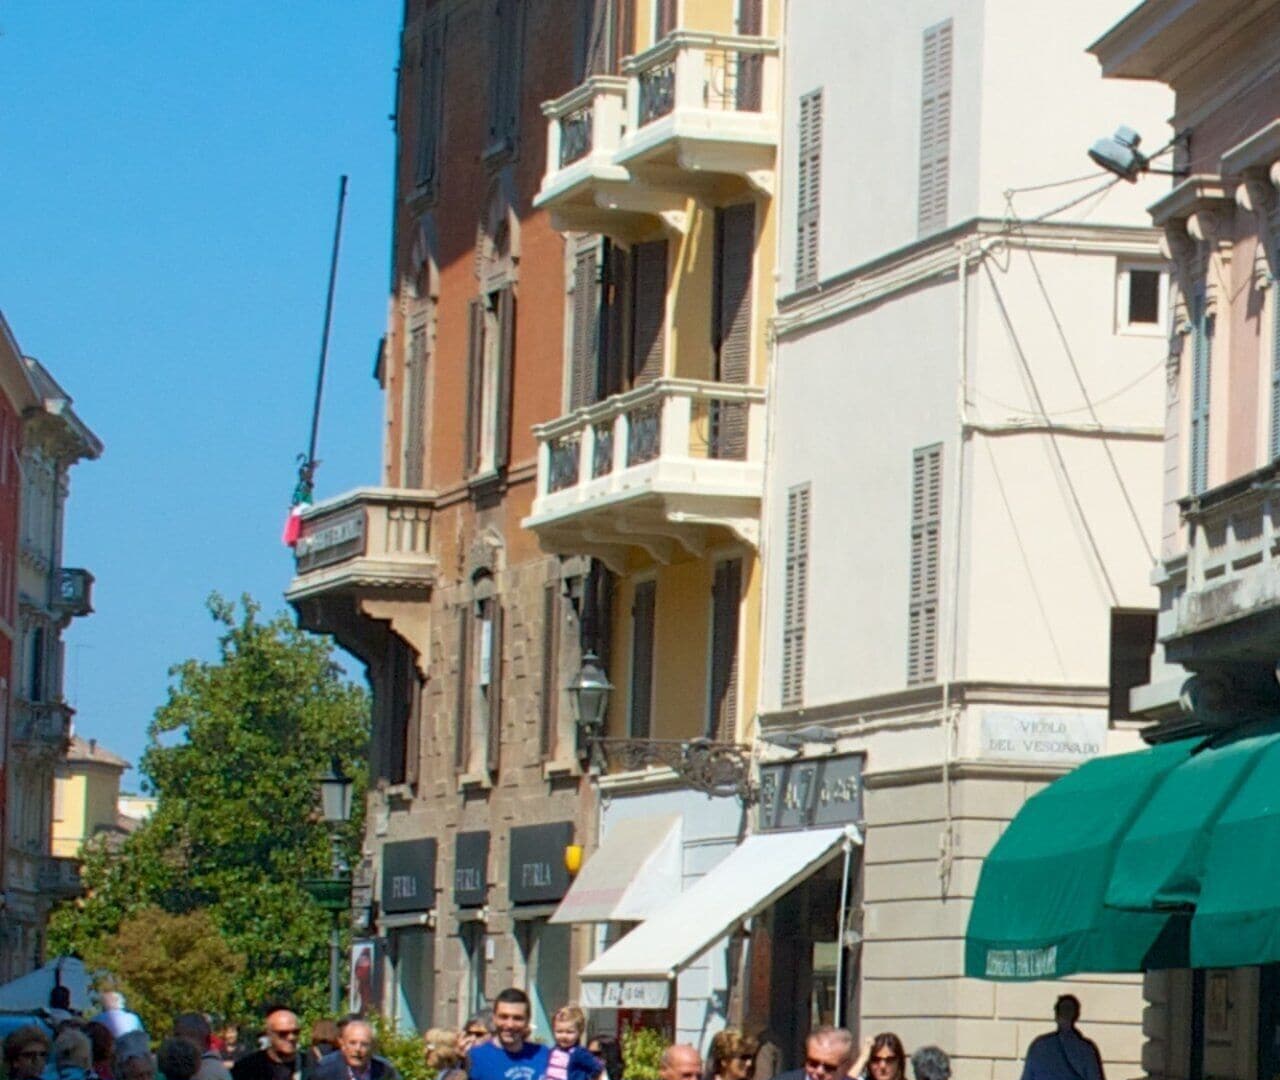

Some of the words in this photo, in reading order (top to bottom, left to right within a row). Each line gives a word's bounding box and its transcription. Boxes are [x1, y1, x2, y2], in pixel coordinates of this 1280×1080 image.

[1019, 719, 1069, 734] VICOLO
[988, 738, 1016, 752] DEL
[522, 861, 552, 888] FURLA
